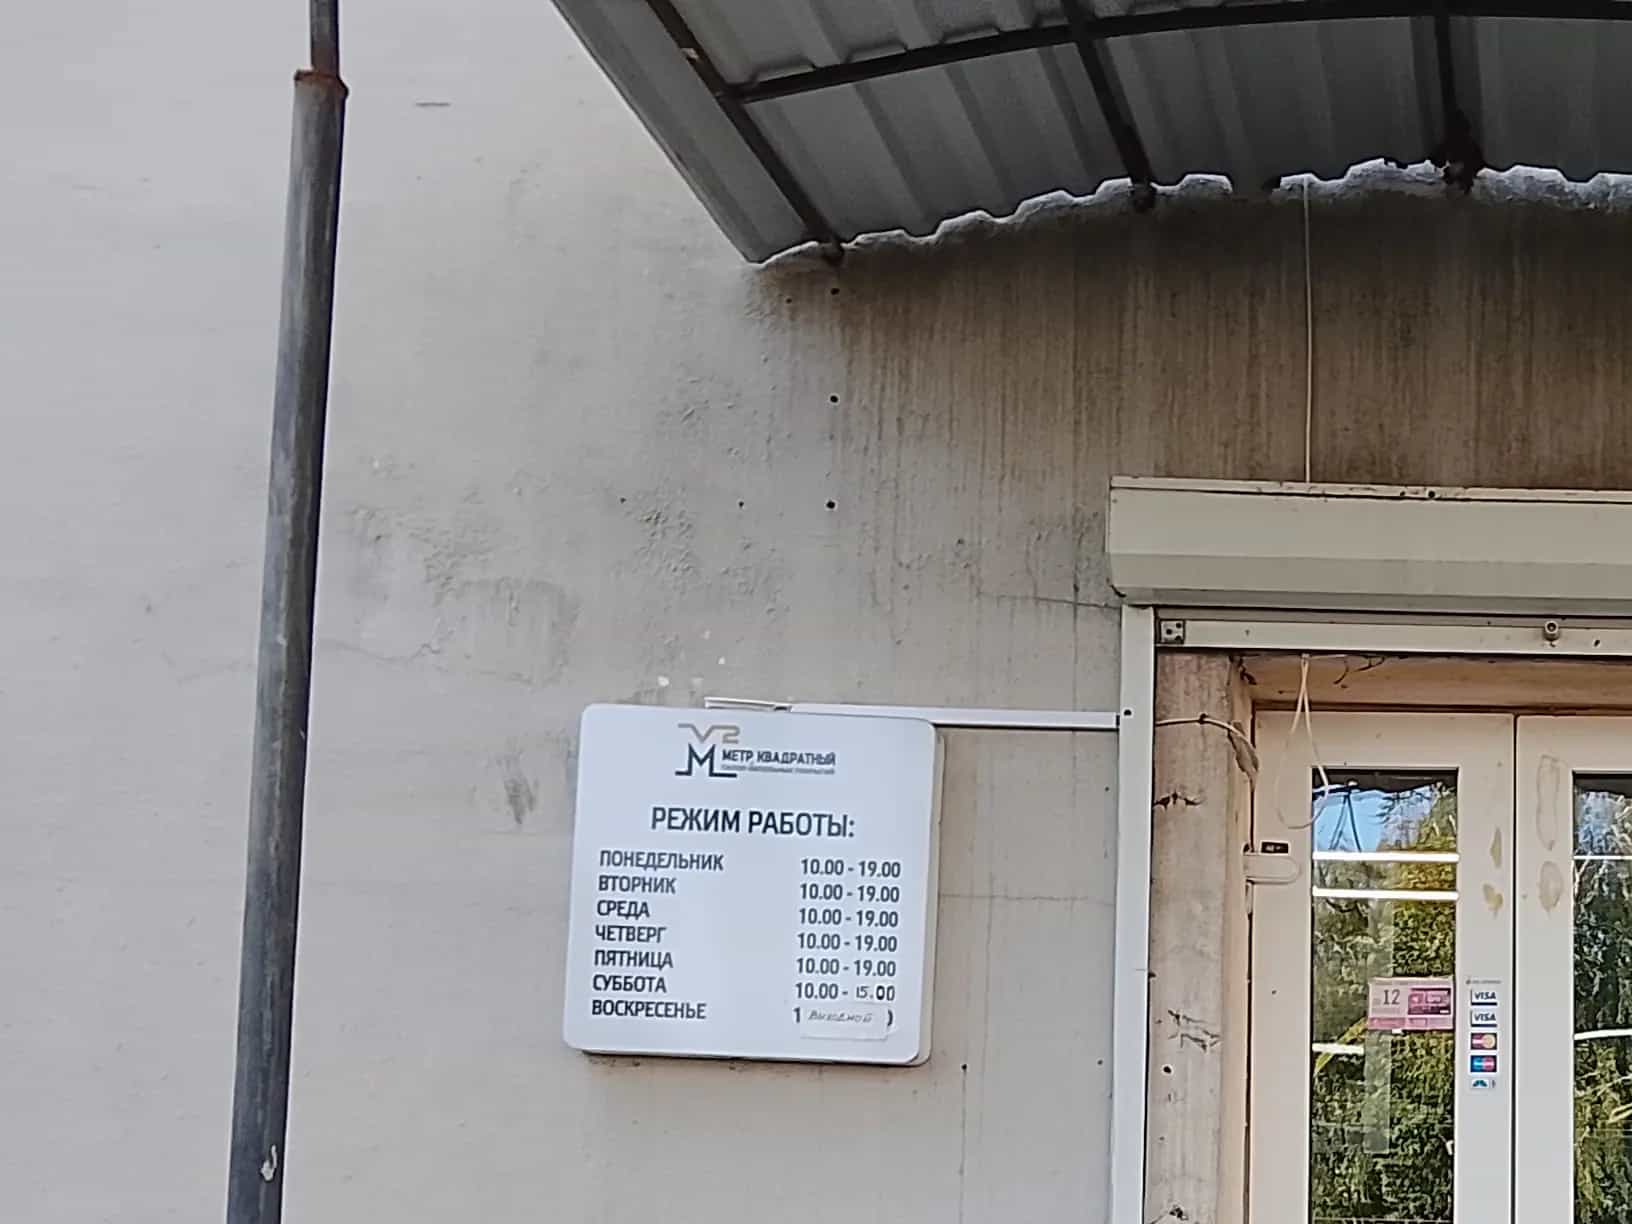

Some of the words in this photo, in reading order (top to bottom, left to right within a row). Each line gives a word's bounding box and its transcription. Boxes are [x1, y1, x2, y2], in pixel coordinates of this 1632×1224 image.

[722, 749, 754, 763] МЕТР
[757, 750, 836, 766] КВАДРАТНЫЙ
[652, 807, 740, 832] РЕЖИМ
[749, 811, 854, 837] РАБОТЫ:
[600, 850, 723, 871] ПОНЕДЕЛЬНИК
[802, 859, 844, 875] 10.00
[859, 861, 900, 878] 19.00
[599, 875, 676, 893] ВТОРНИК
[801, 883, 843, 900] 10.00
[858, 886, 899, 902] 19.00
[597, 900, 650, 920] СРЕДА
[800, 908, 841, 925] 10.00
[857, 910, 898, 927] 19.00
[596, 925, 666, 943] ЧЕТВЕРГ
[798, 933, 840, 950] 10.00
[856, 935, 897, 952] 19.00
[595, 950, 673, 970] ПЯТНИЦА
[797, 958, 839, 974] 10.00
[854, 960, 896, 976] 19.00
[593, 975, 666, 992] СУББОТА
[796, 983, 838, 999] 10.00
[1384, 989, 1400, 1005] 12
[1474, 992, 1496, 1000] VISA
[592, 1000, 706, 1019] ВОСКРЕСЕНЬЕ
